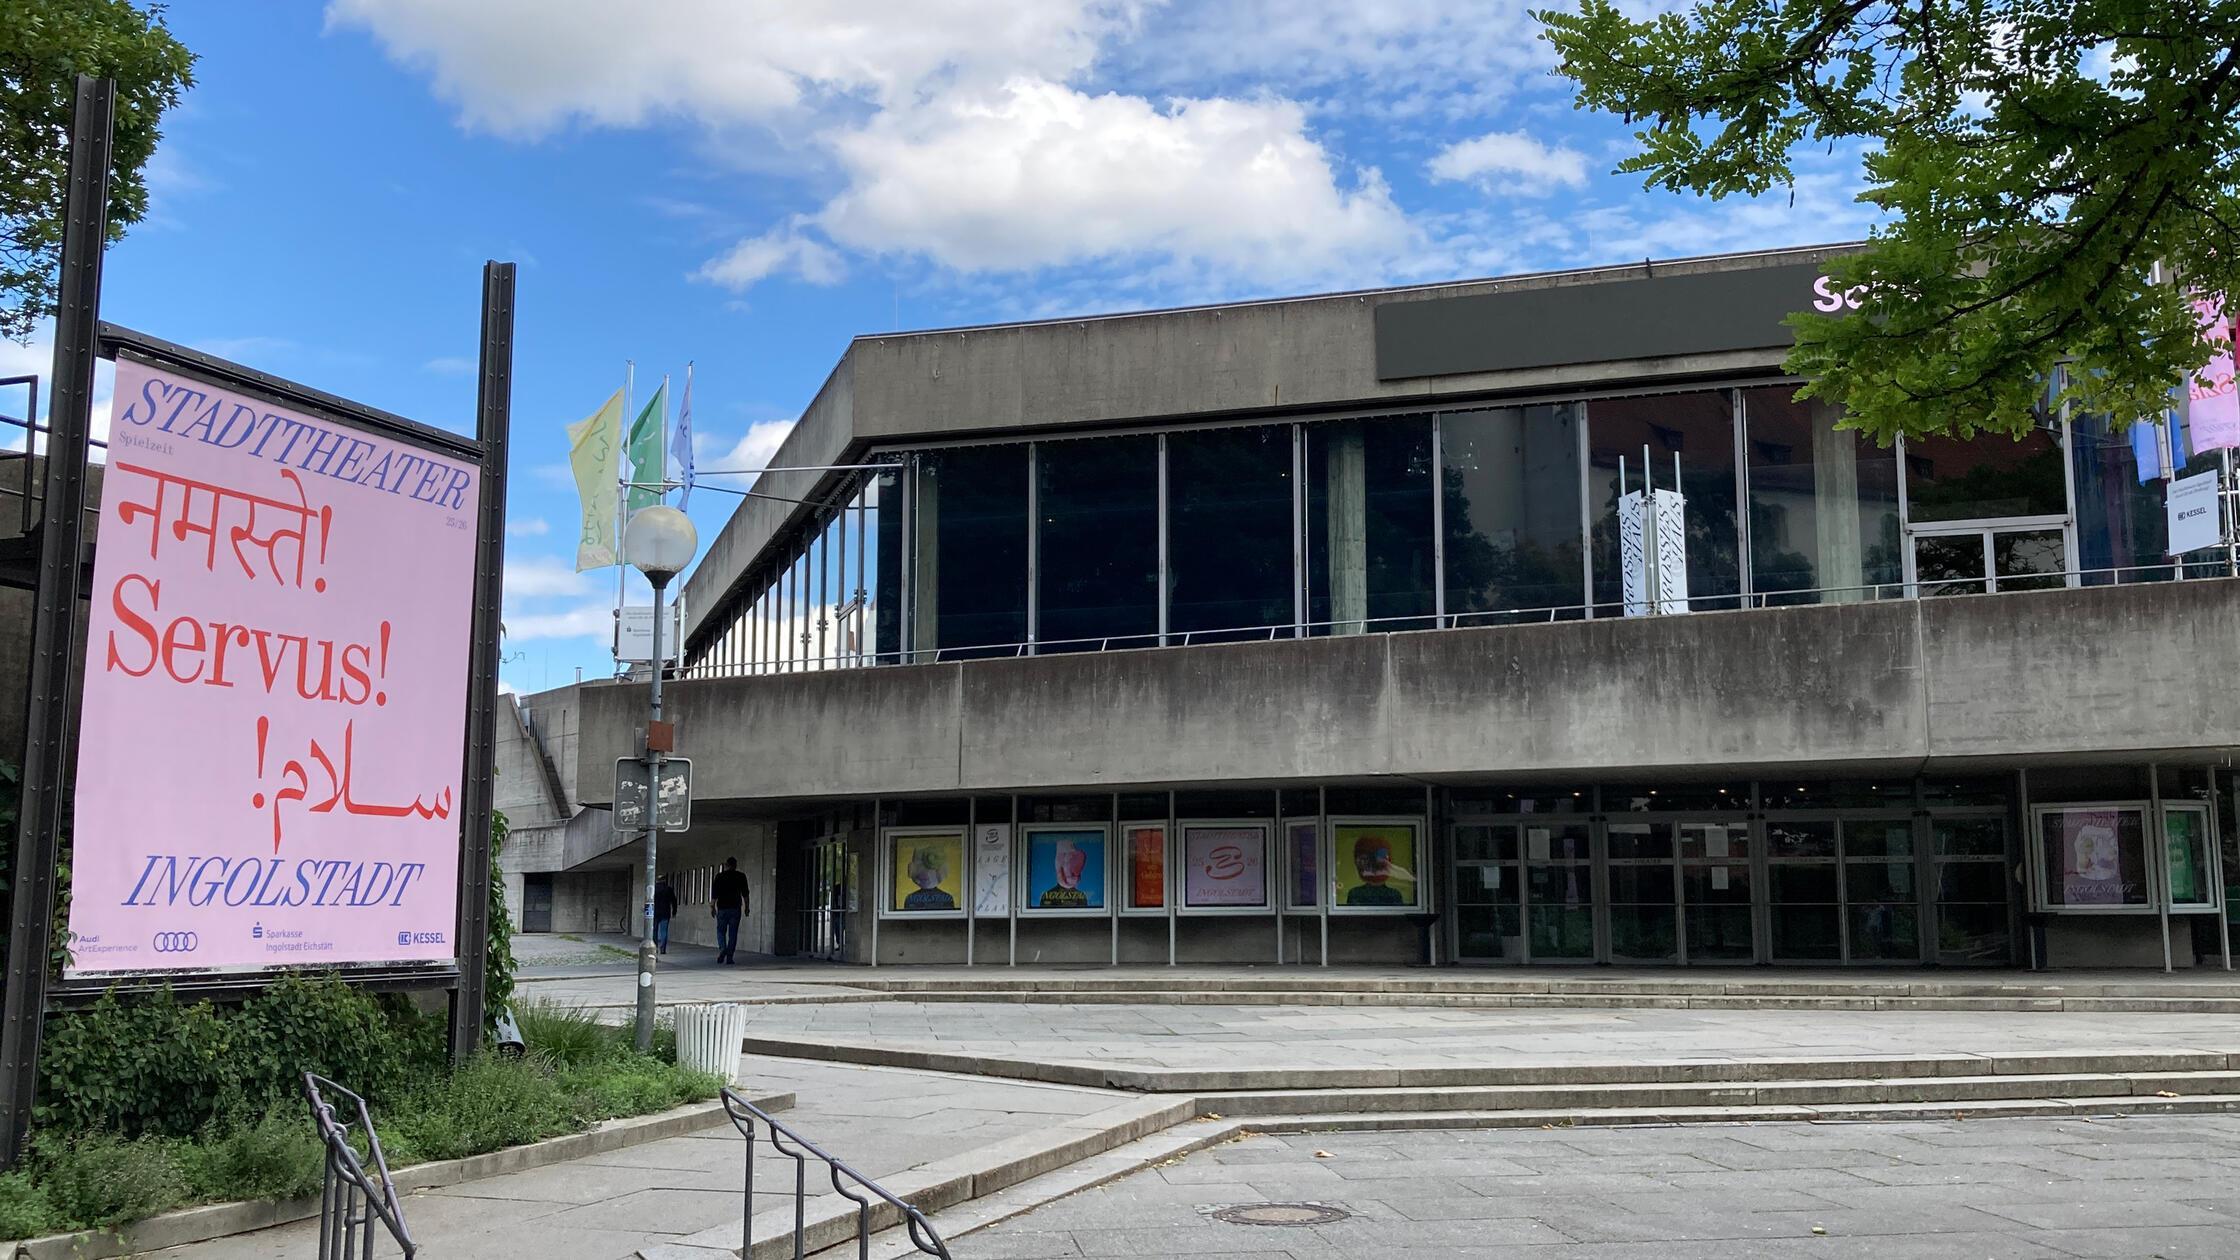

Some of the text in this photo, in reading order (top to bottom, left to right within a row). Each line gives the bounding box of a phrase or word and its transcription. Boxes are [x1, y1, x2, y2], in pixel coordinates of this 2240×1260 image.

[118, 430, 175, 455] Spielzeit
[121, 378, 472, 510] STADTTHEATER
[115, 462, 332, 593] नमस्ते!
[1670, 494, 1684, 564] HAUS
[2186, 506, 2207, 518] KESSEL
[1630, 497, 1643, 566] HAUS
[107, 574, 391, 706] Servus!
[252, 716, 451, 854] سلام!
[121, 856, 425, 907] INGOLSTADT
[78, 945, 138, 954] ArtExperience
[79, 935, 100, 943] Audi
[266, 929, 303, 940] Sparkasse
[266, 942, 302, 953] Ingolstadt
[413, 932, 446, 944] KESSEL
